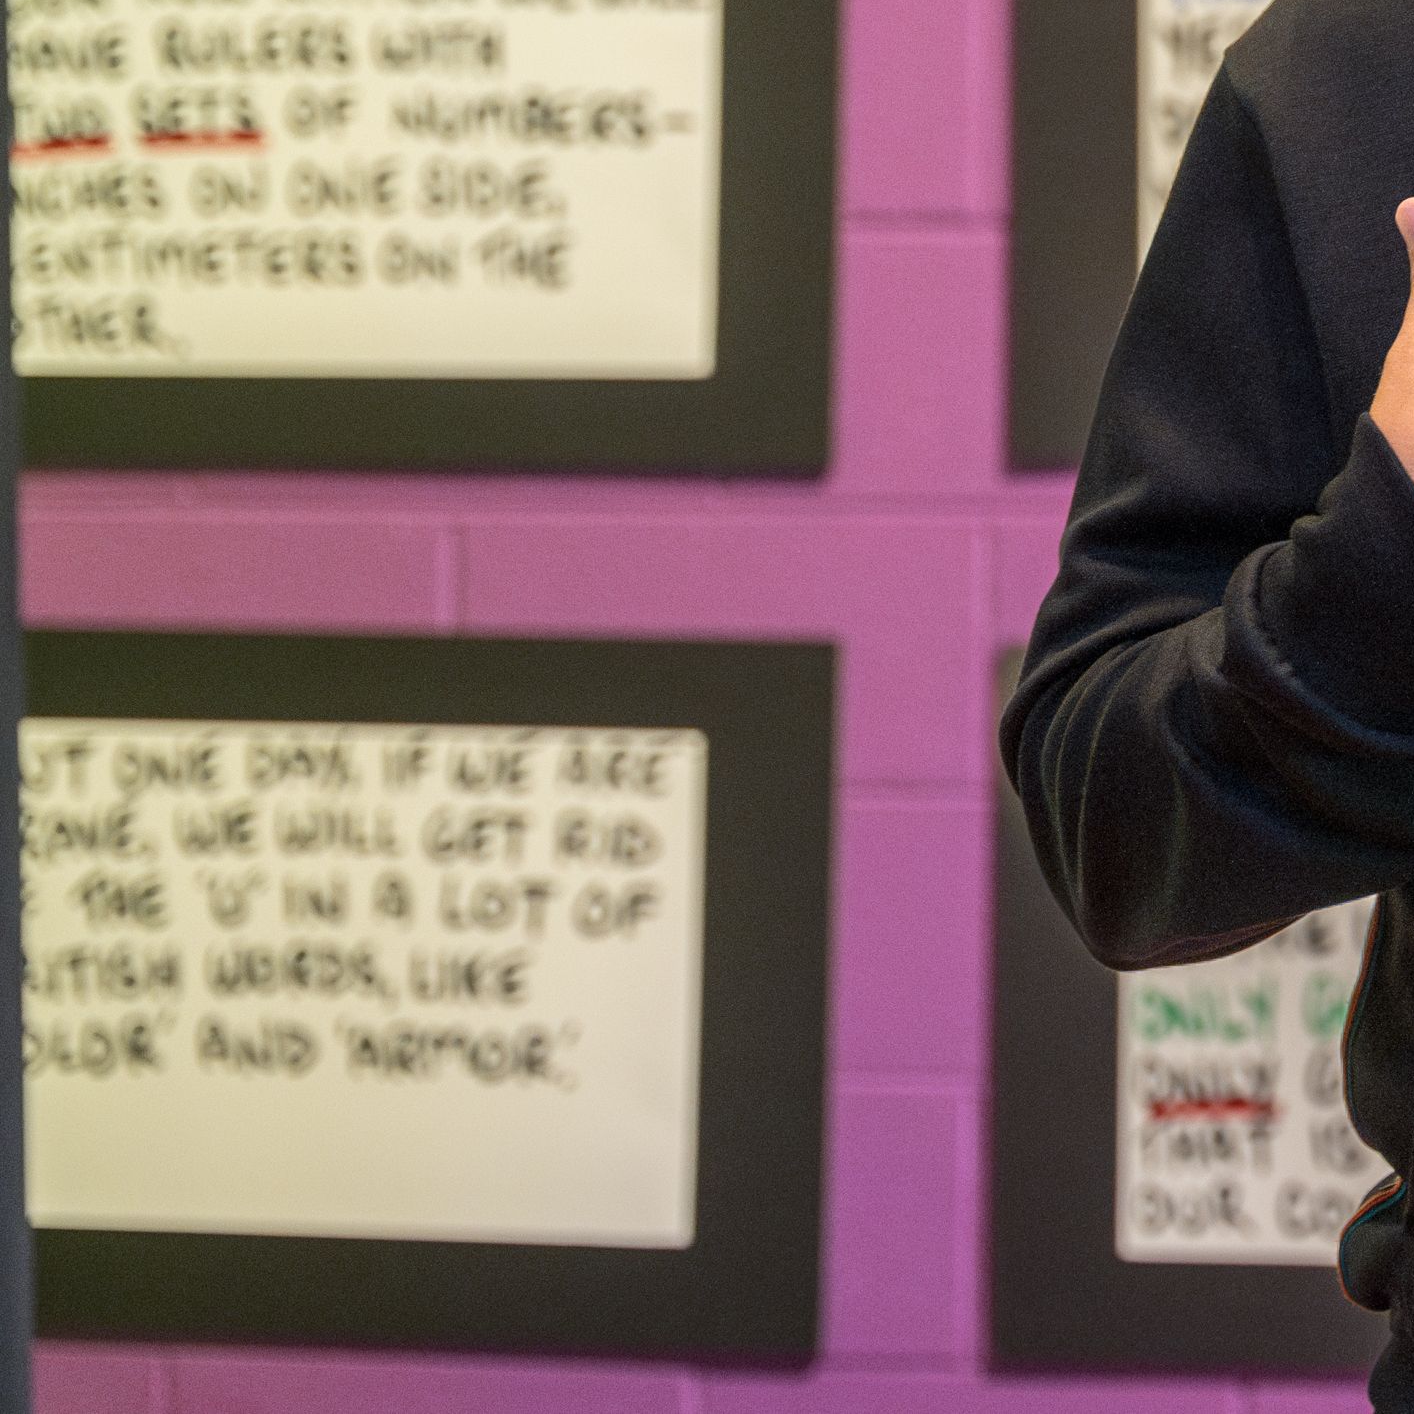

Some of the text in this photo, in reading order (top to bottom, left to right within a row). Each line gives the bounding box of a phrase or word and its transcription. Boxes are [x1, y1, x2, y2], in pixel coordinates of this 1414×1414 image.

[153, 22, 350, 78] RULERS
[373, 22, 505, 73] WITH
[282, 86, 360, 142] OF
[12, 161, 165, 218] NCHES
[187, 159, 266, 217] ON
[284, 155, 406, 218] ONE
[24, 227, 576, 291] ENTIMETERS ON THE
[22, 745, 96, 798] UT
[111, 742, 223, 798] ONE
[380, 739, 434, 792] IF
[448, 744, 532, 796] WE
[554, 746, 671, 798] ARE
[173, 803, 256, 860] WE
[275, 805, 401, 860] WILL
[422, 805, 528, 864] GET
[554, 807, 662, 866] RID
[74, 874, 171, 933] THE
[283, 876, 350, 928] IN
[372, 876, 414, 928] A
[440, 876, 553, 940] LOT
[571, 879, 661, 942] OF
[410, 948, 532, 1004] LIKE
[195, 1020, 320, 1076] AND
